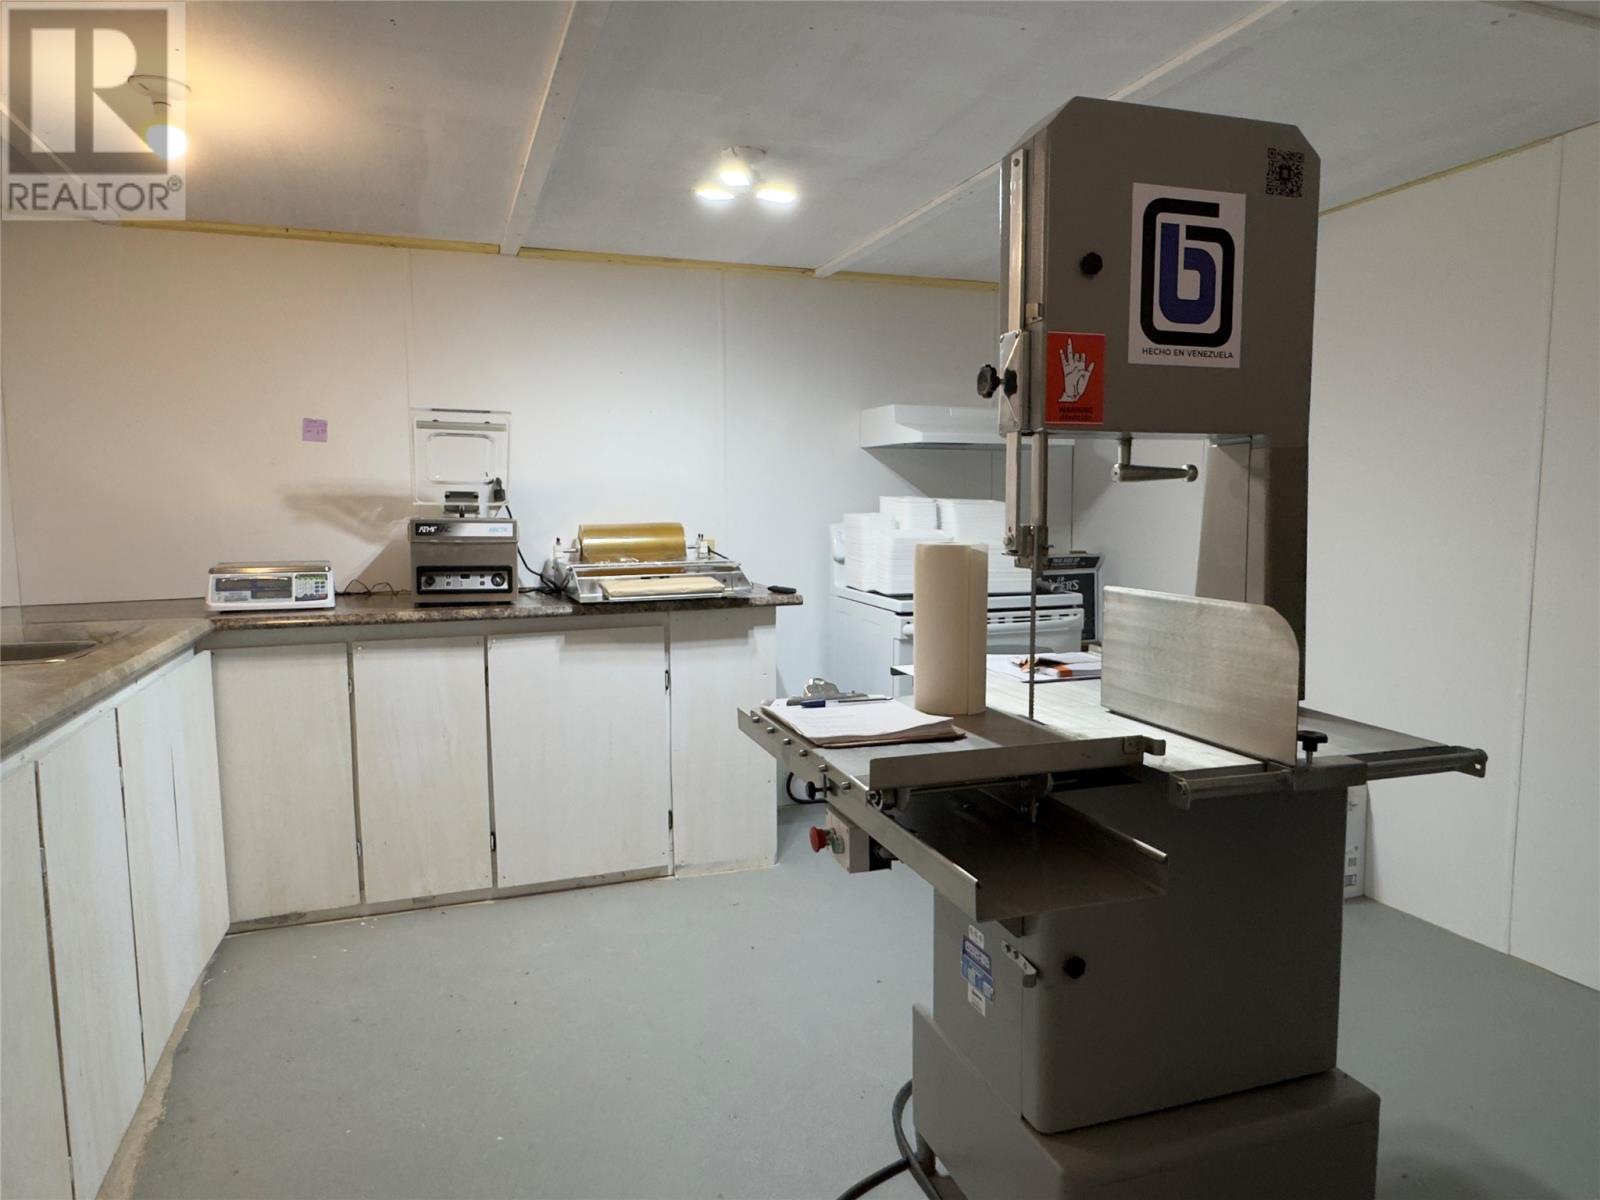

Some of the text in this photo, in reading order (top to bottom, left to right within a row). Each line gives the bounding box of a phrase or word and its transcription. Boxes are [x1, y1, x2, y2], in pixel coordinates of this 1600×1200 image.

[1142, 347, 1233, 359] HECHO EN VENEZUELA
